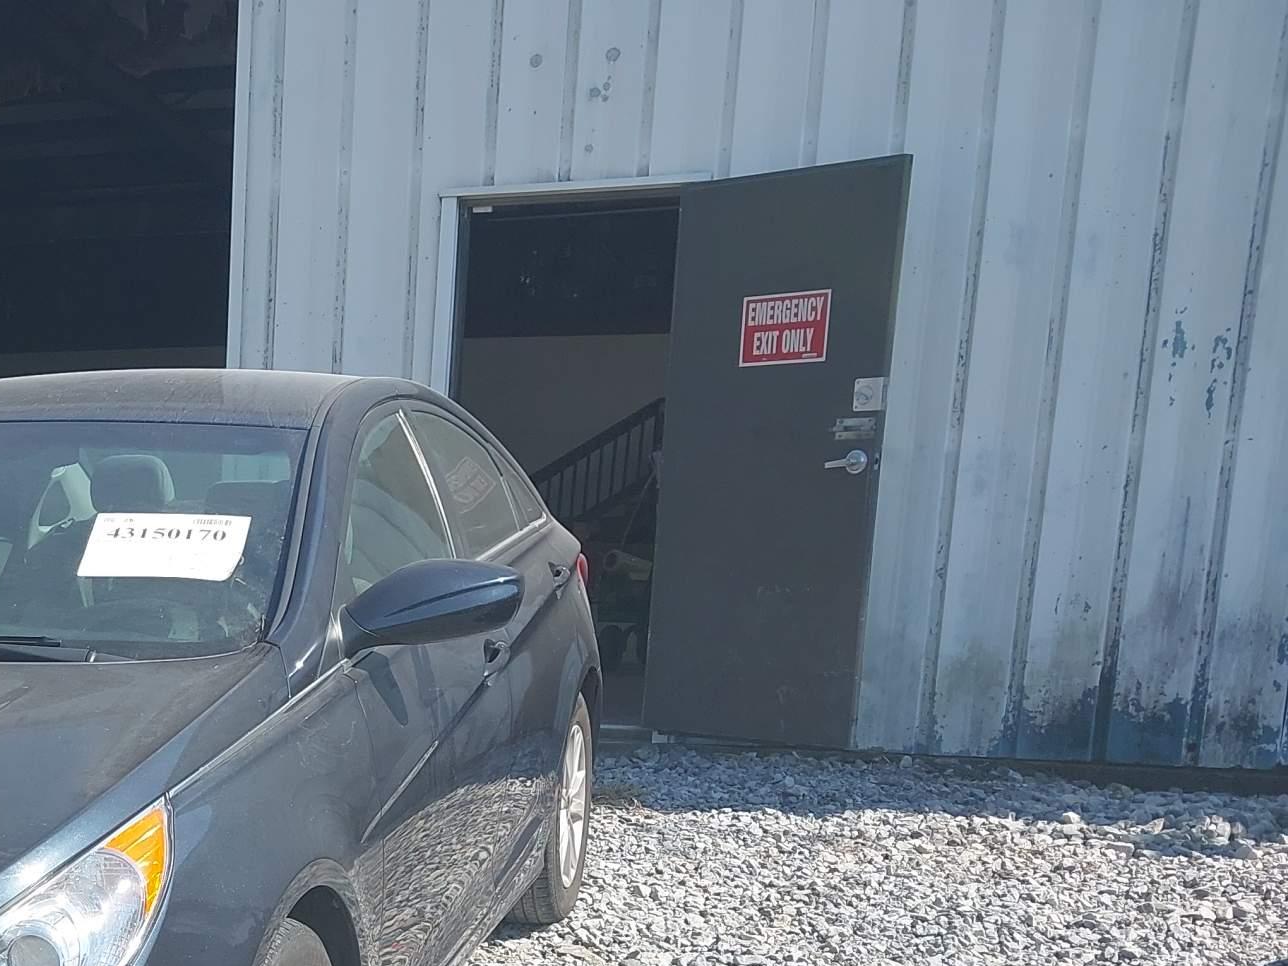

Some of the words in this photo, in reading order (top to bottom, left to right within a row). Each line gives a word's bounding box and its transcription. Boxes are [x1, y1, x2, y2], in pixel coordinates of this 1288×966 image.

[748, 296, 824, 327] EMERGENCY
[753, 330, 779, 356] EXIT
[781, 327, 814, 354] ONLY
[106, 527, 227, 542] 43150170
